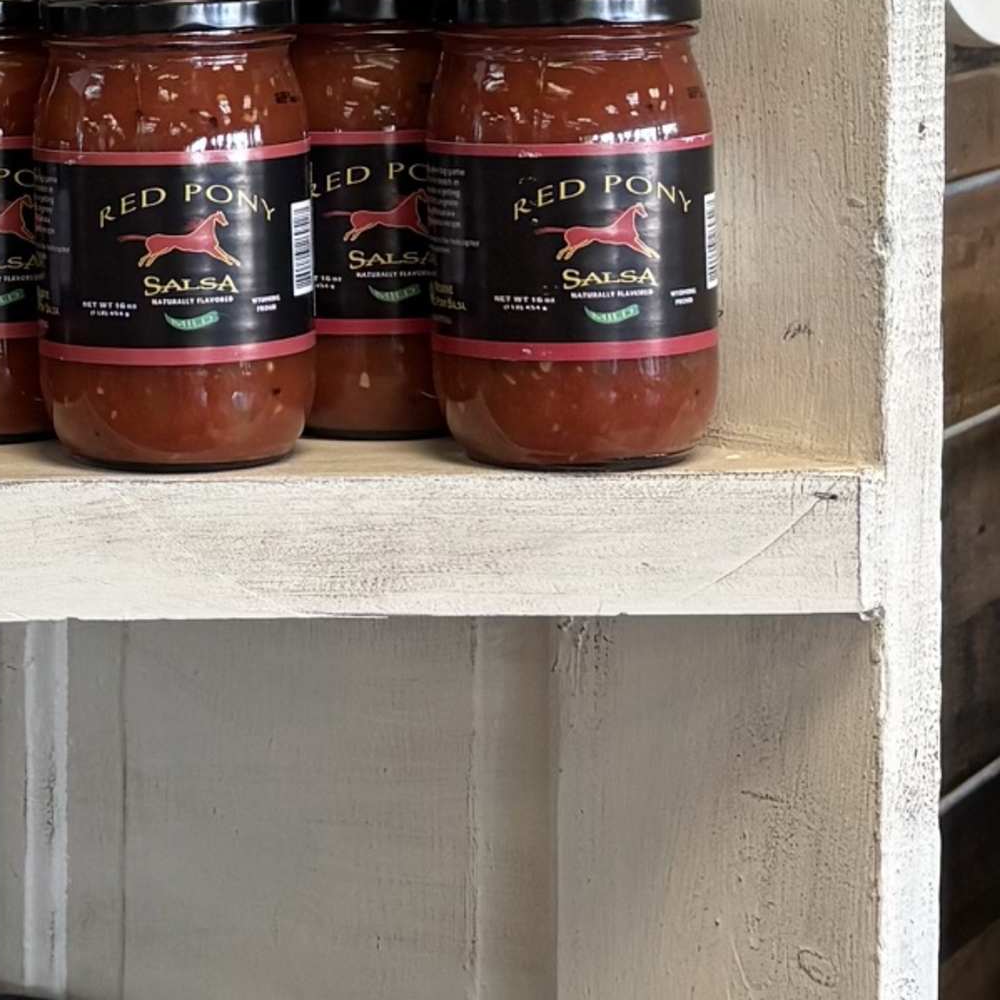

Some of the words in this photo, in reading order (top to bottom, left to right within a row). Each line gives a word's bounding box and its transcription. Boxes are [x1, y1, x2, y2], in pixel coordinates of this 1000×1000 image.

[388, 163, 428, 181] PO
[99, 187, 167, 228] RED
[185, 184, 276, 222] PONY
[513, 179, 586, 221] RED
[604, 175, 691, 213] PONY
[143, 275, 239, 297] SALSA
[562, 268, 658, 290] SALSA
[151, 297, 194, 305] NATURALLY
[196, 296, 234, 304] FLAVORED
[571, 291, 615, 299] NATURALLY
